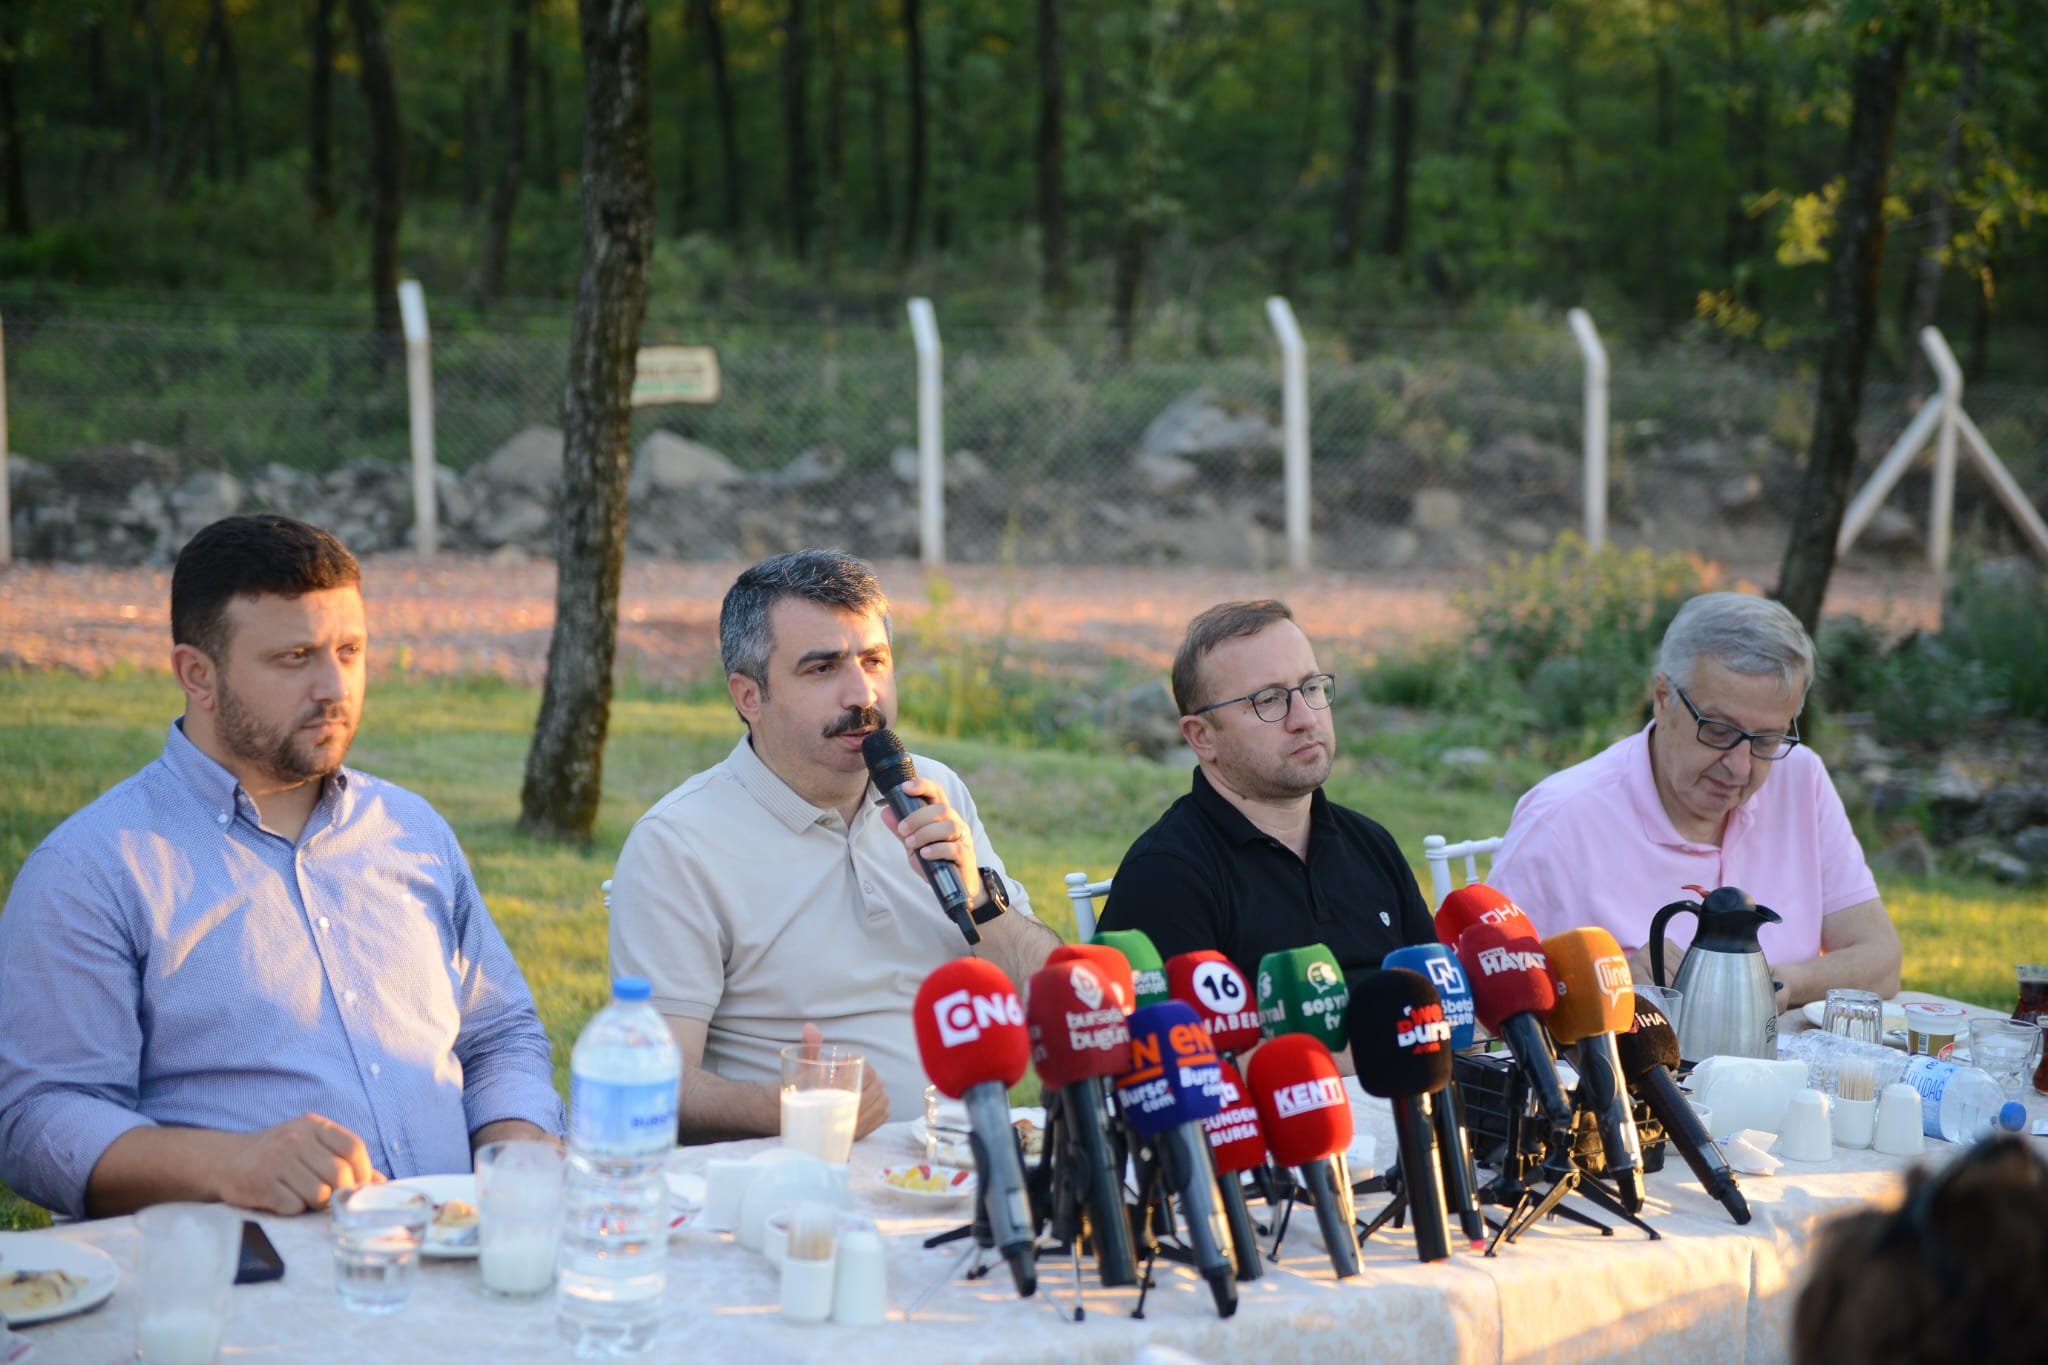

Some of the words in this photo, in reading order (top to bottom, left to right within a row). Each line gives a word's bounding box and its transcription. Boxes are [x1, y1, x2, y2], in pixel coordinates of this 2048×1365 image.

[1478, 951, 1546, 976] HAYAT
[1202, 973, 1240, 1001] 16
[1209, 1123, 1258, 1147] BURSA
